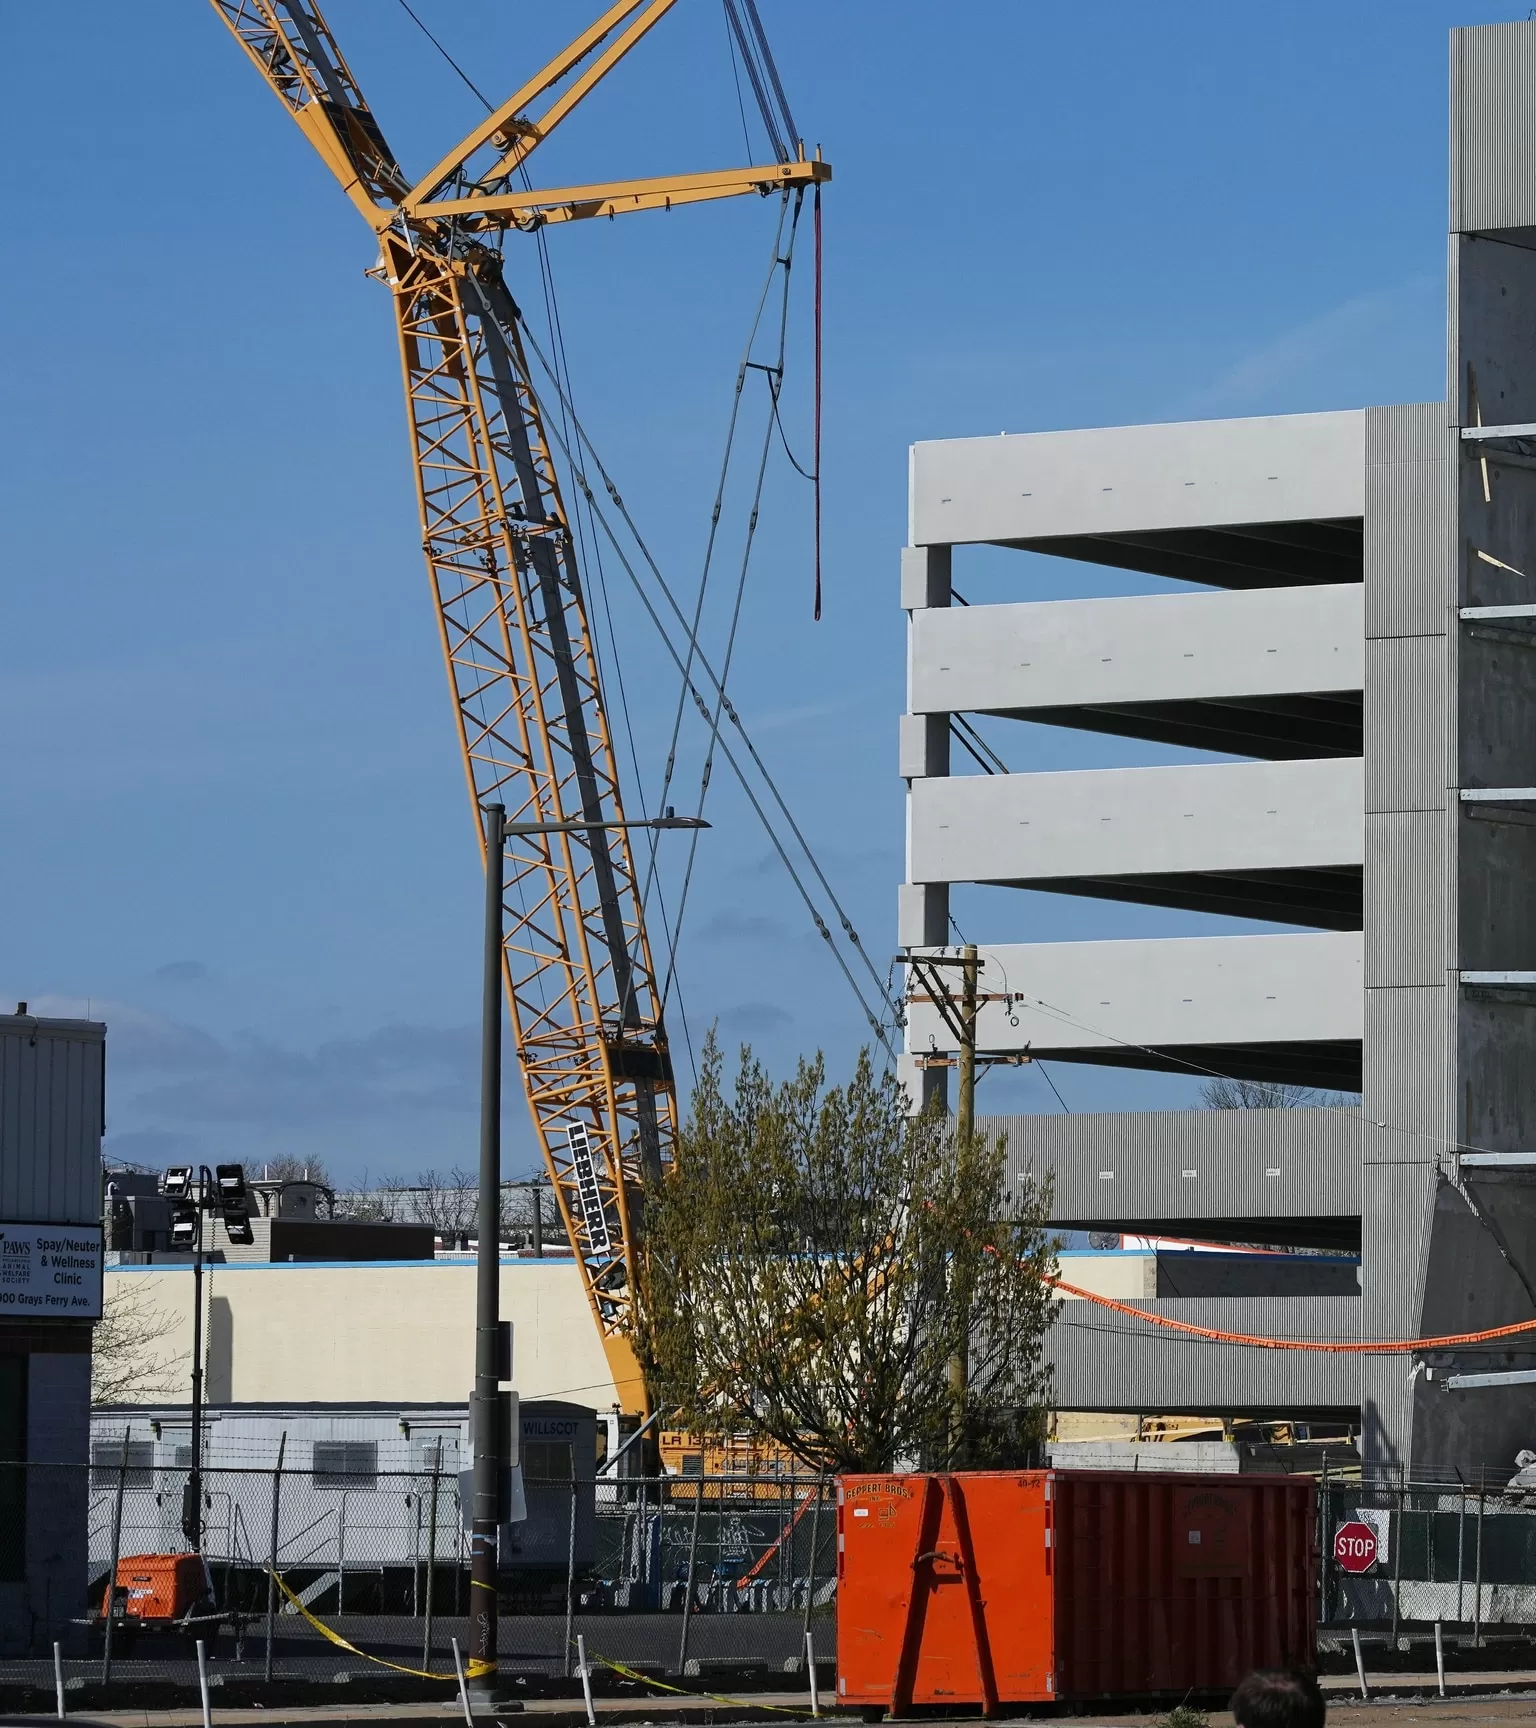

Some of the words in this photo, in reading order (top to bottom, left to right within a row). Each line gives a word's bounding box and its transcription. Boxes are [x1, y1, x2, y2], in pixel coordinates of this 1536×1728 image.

[568, 1124, 608, 1250] LIEBHERR
[3, 1241, 30, 1255] PAWS
[37, 1237, 100, 1252] Spay/Neuter
[41, 1255, 48, 1266] &
[51, 1256, 95, 1268] Wellness
[54, 1272, 82, 1285] Clinic
[18, 1294, 43, 1306] Grays
[45, 1294, 69, 1307] Ferry
[71, 1296, 90, 1306] Ave.
[523, 1422, 579, 1436] WILLSCOT
[663, 1436, 681, 1445] LR
[846, 1483, 881, 1499] GEPPERT
[1338, 1537, 1374, 1557] STOP
